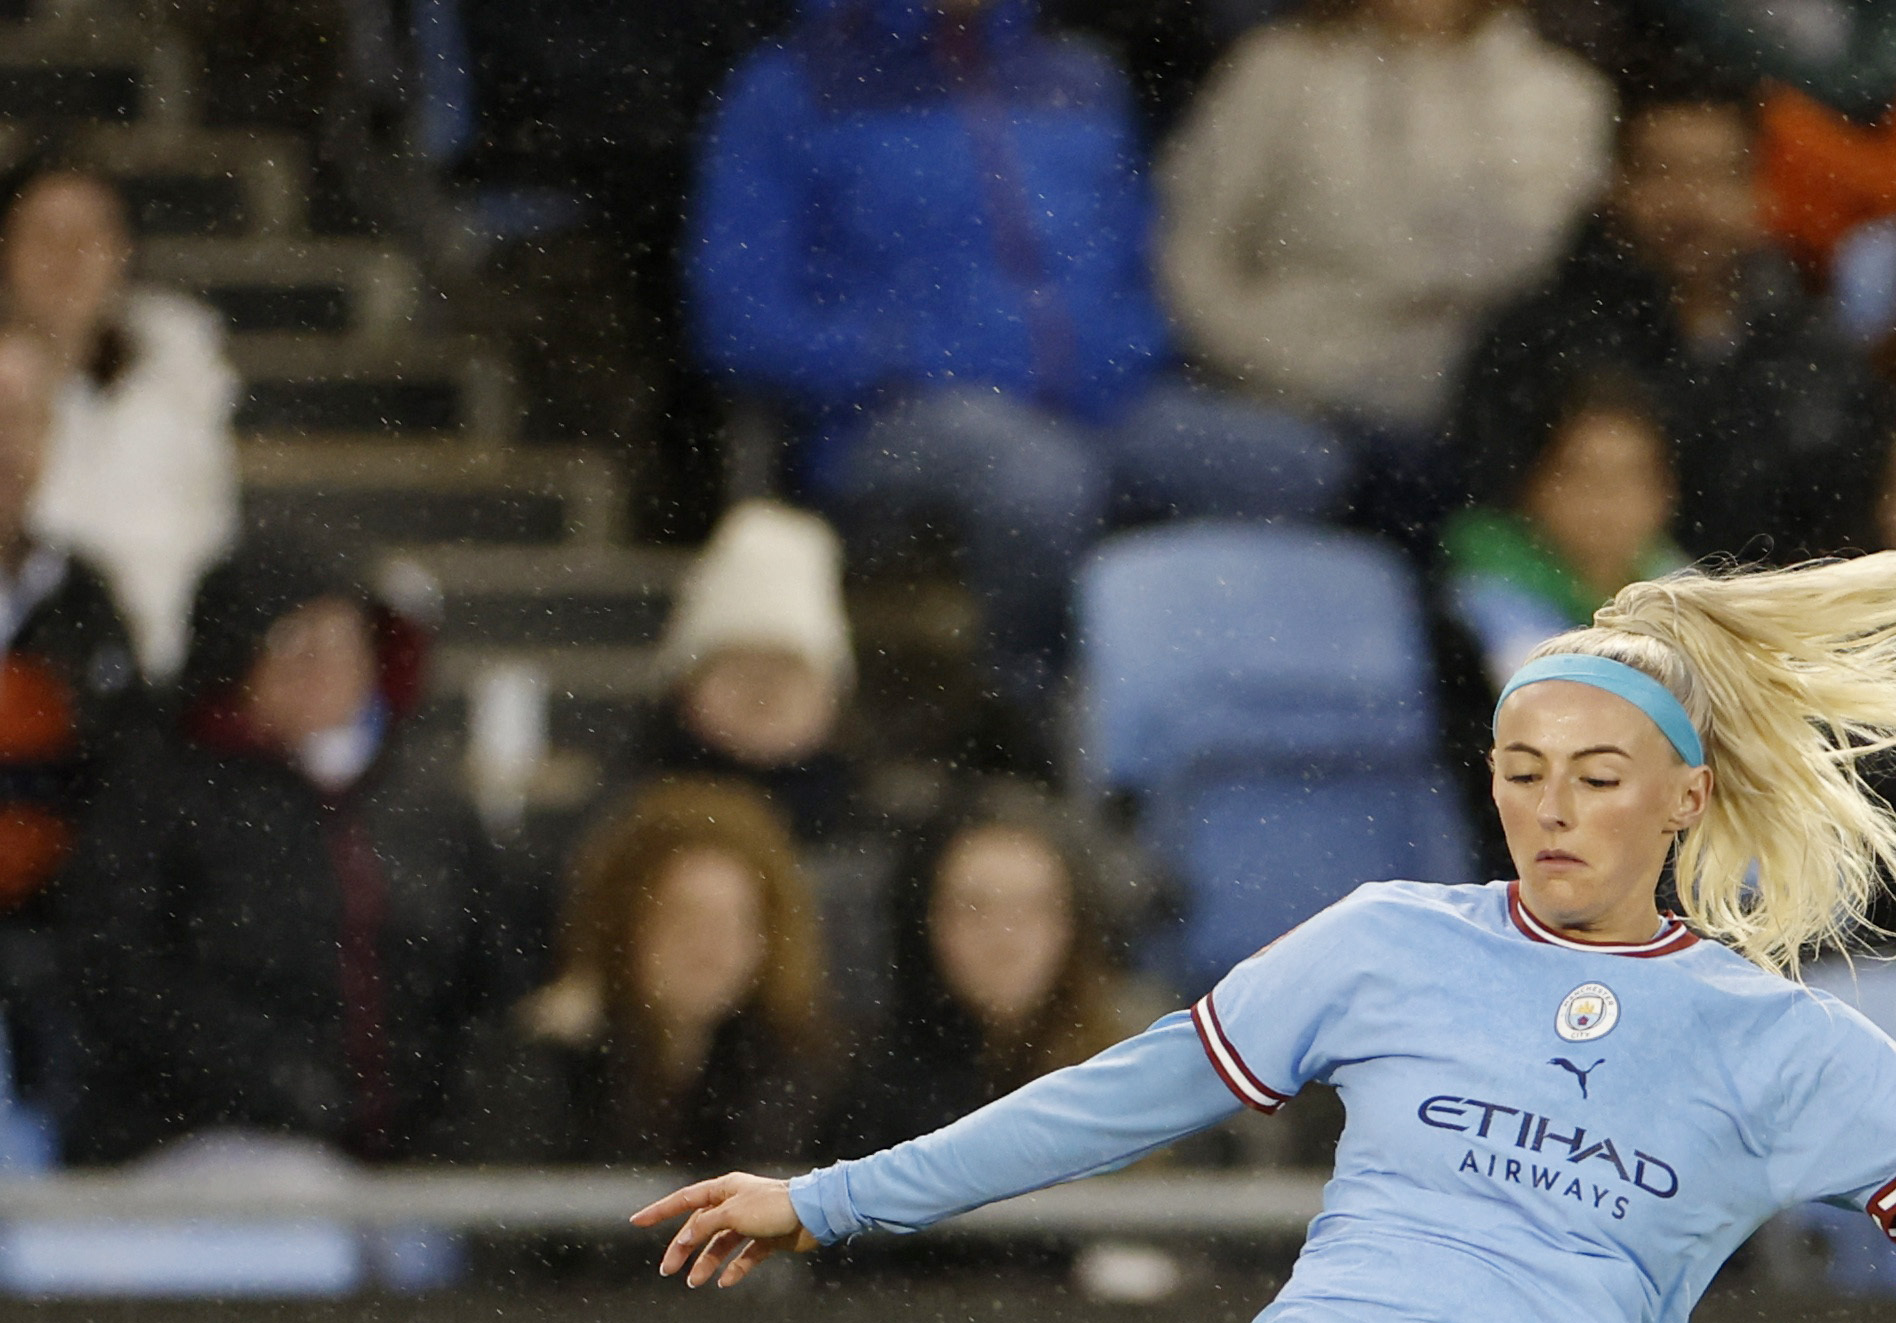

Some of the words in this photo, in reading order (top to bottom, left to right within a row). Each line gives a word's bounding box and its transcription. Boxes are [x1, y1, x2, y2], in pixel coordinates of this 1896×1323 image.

[1563, 985, 1615, 1007] MANCHESTER
[1570, 1031, 1591, 1039] CITY
[1417, 1094, 1680, 1199] ETIHAD
[1459, 1148, 1630, 1220] AIRWAYS
